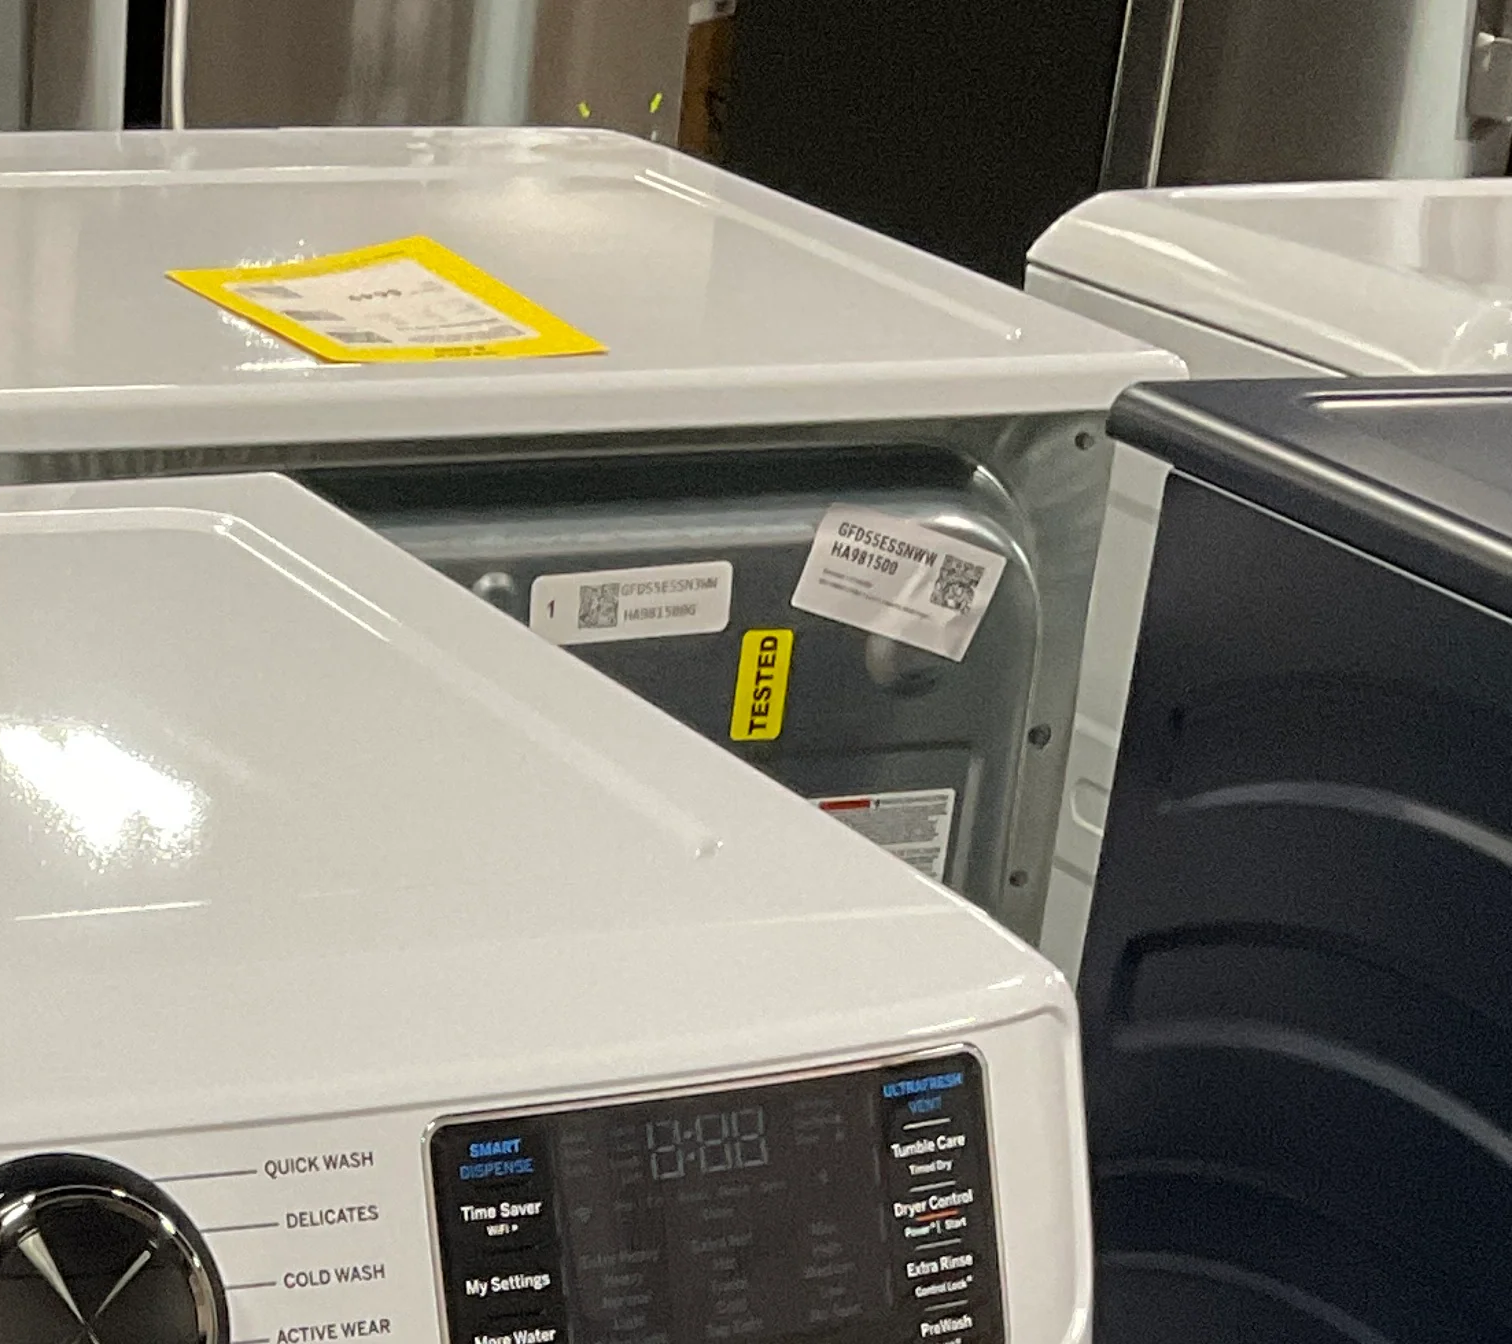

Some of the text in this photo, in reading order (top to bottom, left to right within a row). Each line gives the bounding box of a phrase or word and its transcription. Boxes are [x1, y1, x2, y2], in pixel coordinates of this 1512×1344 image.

[831, 540, 899, 576] HA981500
[546, 600, 555, 618] 1
[748, 635, 779, 736] TESTED
[883, 1072, 964, 1098] ULTRAFRESH
[908, 1097, 942, 1115] VENT
[469, 1138, 521, 1158] SMART
[890, 1134, 966, 1159] Tumble Care
[264, 1151, 374, 1180] QUICK WASH
[459, 1158, 534, 1180] DISPENSE
[936, 1159, 953, 1171] Dry
[460, 1202, 543, 1221] Time Saver
[893, 1188, 974, 1218] Dryer Control
[286, 1204, 380, 1229] DELICATES
[283, 1264, 386, 1289] COLD WASH
[906, 1254, 974, 1278] Extra Rinse
[465, 1273, 551, 1298] My Settings
[276, 1318, 392, 1344] ACTIVE WEAR
[920, 1313, 974, 1338] PreWash
